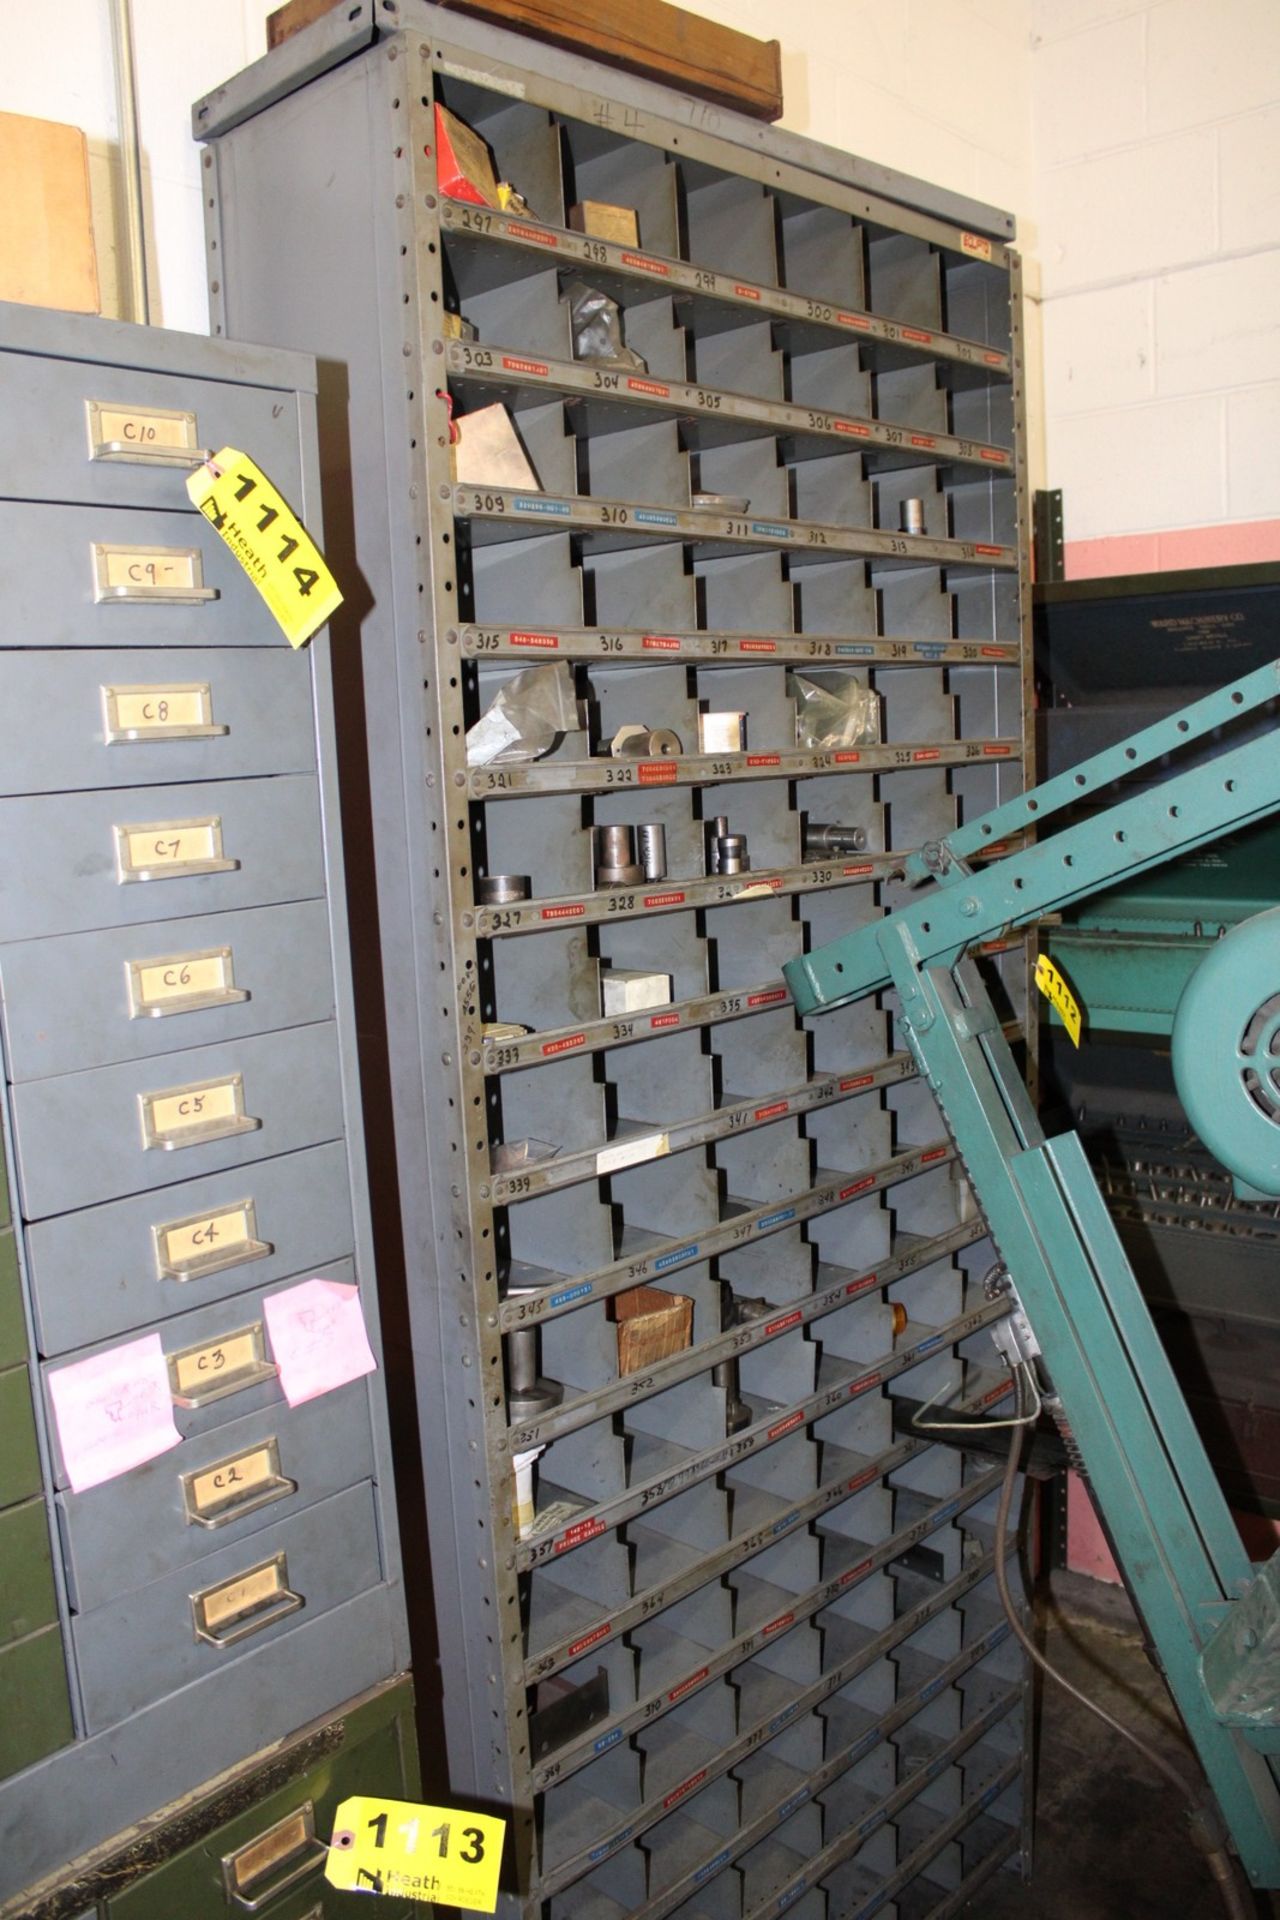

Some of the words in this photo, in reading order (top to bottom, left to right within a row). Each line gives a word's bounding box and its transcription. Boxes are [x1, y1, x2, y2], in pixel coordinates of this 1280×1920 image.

[462, 209, 492, 233] 297
[583, 242, 607, 263] 298
[695, 273, 716, 291] 299
[807, 301, 832, 321] 300
[463, 347, 493, 367] 303
[593, 372, 619, 389] 304
[698, 391, 722, 408] 305
[808, 413, 832, 430] 306
[123, 422, 156, 442] C10
[885, 428, 903, 443] 307
[474, 494, 505, 513] 309
[601, 507, 627, 524] 310
[234, 474, 320, 597] 1114
[726, 522, 748, 536] 311
[809, 530, 827, 544] 312
[227, 522, 268, 579] Heath
[891, 540, 908, 554] 313
[476, 633, 500, 650] 315
[600, 636, 623, 652] 316
[711, 640, 728, 653] 317
[810, 641, 831, 657] 318
[143, 700, 168, 722] C8
[606, 769, 632, 783] 322
[712, 763, 732, 775] 323
[487, 774, 513, 789] 321
[155, 839, 181, 858] C7
[812, 871, 832, 884] 330
[608, 896, 635, 912] 328
[491, 911, 522, 930] 327
[163, 965, 191, 986] C6
[1047, 969, 1077, 1025] 1112
[720, 1000, 741, 1013] 335
[613, 1023, 633, 1039] 334
[817, 1086, 834, 1099] 342
[178, 1095, 205, 1115] C5
[728, 1113, 748, 1129] 341
[508, 1177, 530, 1194] 339
[192, 1222, 219, 1245] C4
[733, 1224, 752, 1239] 347
[628, 1264, 648, 1278] 346
[517, 1300, 544, 1320] 345
[197, 1349, 226, 1370] C3
[519, 1428, 539, 1443] 351
[213, 1466, 243, 1489] C2
[529, 1539, 554, 1563] 357
[367, 1812, 485, 1864] 1113
[386, 1869, 440, 1891] Heath
